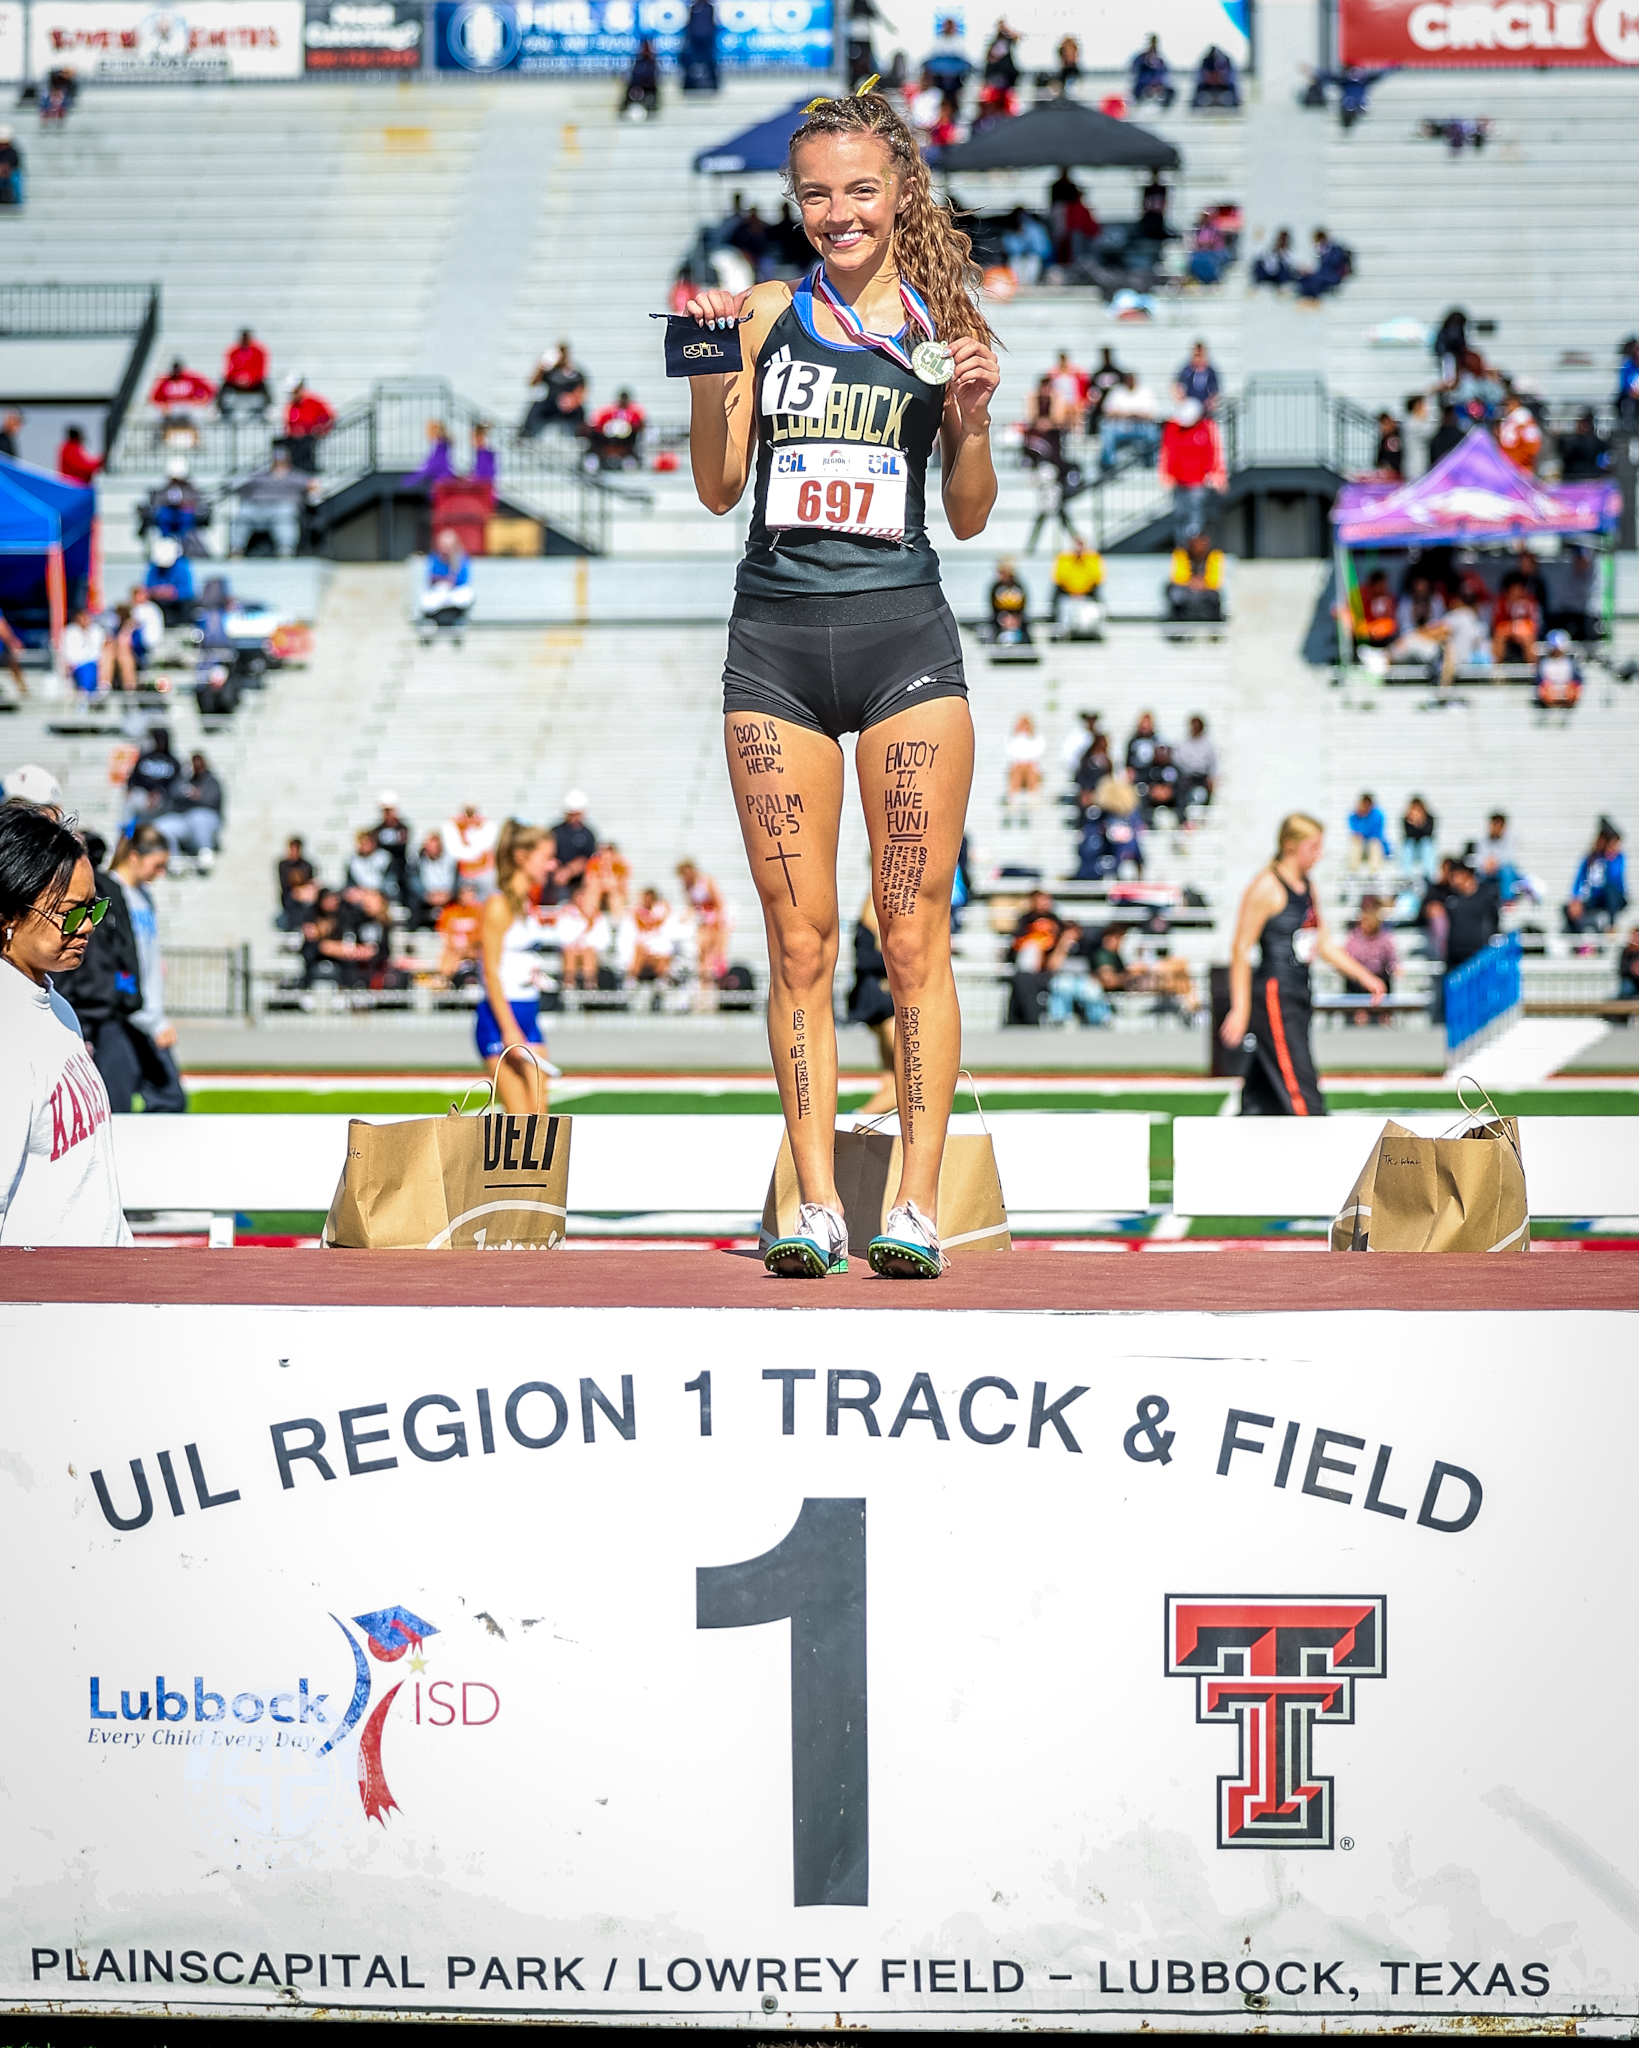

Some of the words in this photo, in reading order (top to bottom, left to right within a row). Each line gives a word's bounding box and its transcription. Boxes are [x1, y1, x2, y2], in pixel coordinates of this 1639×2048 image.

[776, 364, 821, 411] 13
[797, 480, 875, 524] 697
[763, 720, 778, 741] IS
[737, 743, 782, 758] WITHIN
[885, 741, 940, 774] ENJOY
[896, 769, 917, 790] IT,
[746, 794, 805, 814] PSALM
[885, 789, 923, 811] HAVE
[757, 813, 801, 837] 46:5
[886, 810, 928, 833] FUN!
[918, 846, 928, 866] GOD
[795, 1008, 806, 1031] GOD
[796, 1032, 805, 1042] IS
[797, 1043, 806, 1059] MY
[910, 1040, 923, 1072] PLAN
[797, 1060, 811, 1116] STRENGTH!
[913, 1081, 926, 1113] MINE
[90, 1442, 241, 1531] UIL
[269, 1374, 636, 1490] REGION
[684, 1370, 712, 1436] 1
[762, 1369, 1091, 1453] TRACK
[1123, 1394, 1177, 1466] &
[1216, 1408, 1484, 1533] FIELD
[89, 1675, 330, 1724] Lubbock
[415, 1680, 501, 1727] ISD
[696, 1497, 869, 1907] 1
[88, 1727, 145, 1749] Every
[152, 1728, 205, 1747] Child
[211, 1730, 270, 1752] Every
[274, 1731, 316, 1752] Day
[32, 1946, 426, 1989] PLAINSCAPITAL
[448, 1955, 586, 1990] PARK
[638, 1957, 858, 1993] LOWREY
[881, 1958, 1025, 1993] FIELD
[1099, 1960, 1359, 2001] LUBBOCK,
[1381, 1961, 1551, 1997] TEXAS
